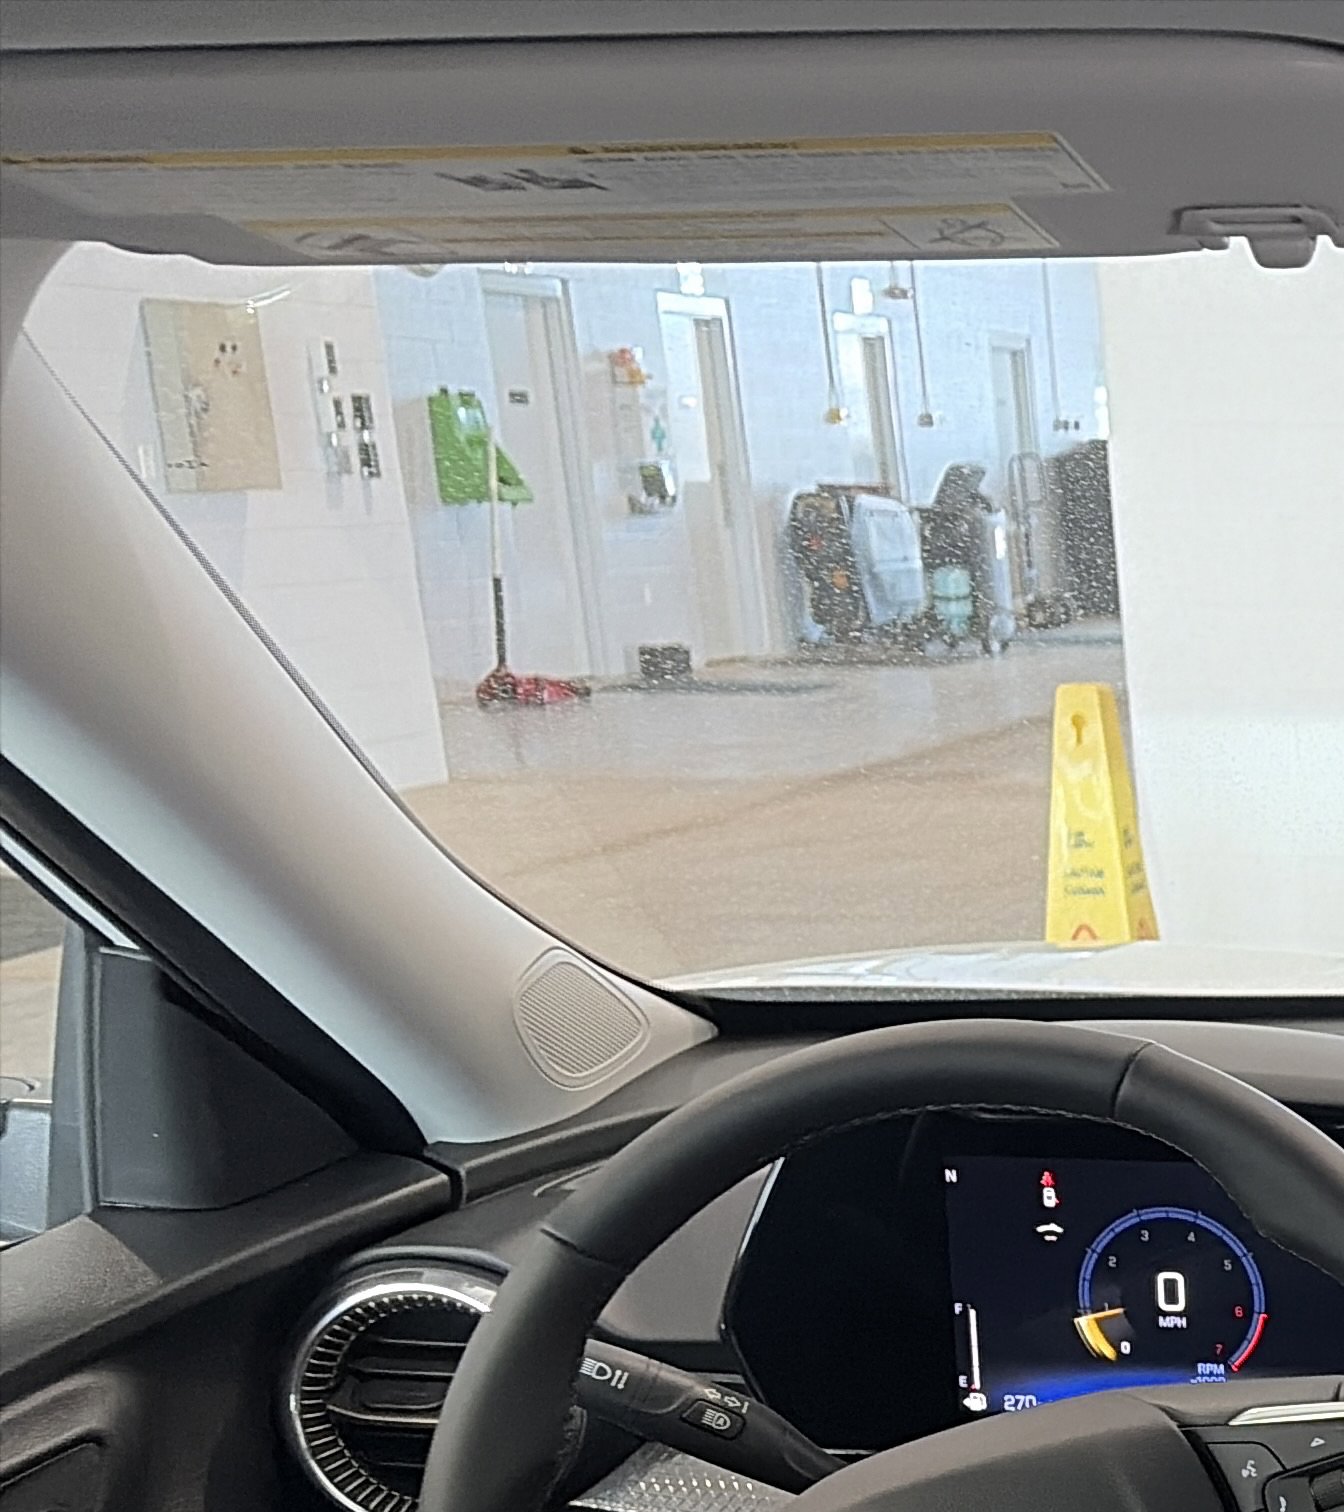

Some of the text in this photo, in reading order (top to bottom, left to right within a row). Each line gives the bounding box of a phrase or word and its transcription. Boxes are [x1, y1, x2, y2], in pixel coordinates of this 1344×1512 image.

[944, 1168, 958, 1183] N
[1141, 1229, 1150, 1242] 3
[1187, 1231, 1196, 1243] 4
[1108, 1255, 1118, 1268] 2
[1223, 1259, 1233, 1271] 5
[1157, 1271, 1186, 1312] 0
[954, 1302, 963, 1315] F
[1234, 1305, 1244, 1318] 6
[1158, 1315, 1187, 1329] MPH
[1120, 1341, 1131, 1354] 0
[1215, 1343, 1224, 1357] 7
[1197, 1362, 1225, 1376] RPM
[958, 1375, 968, 1388] E
